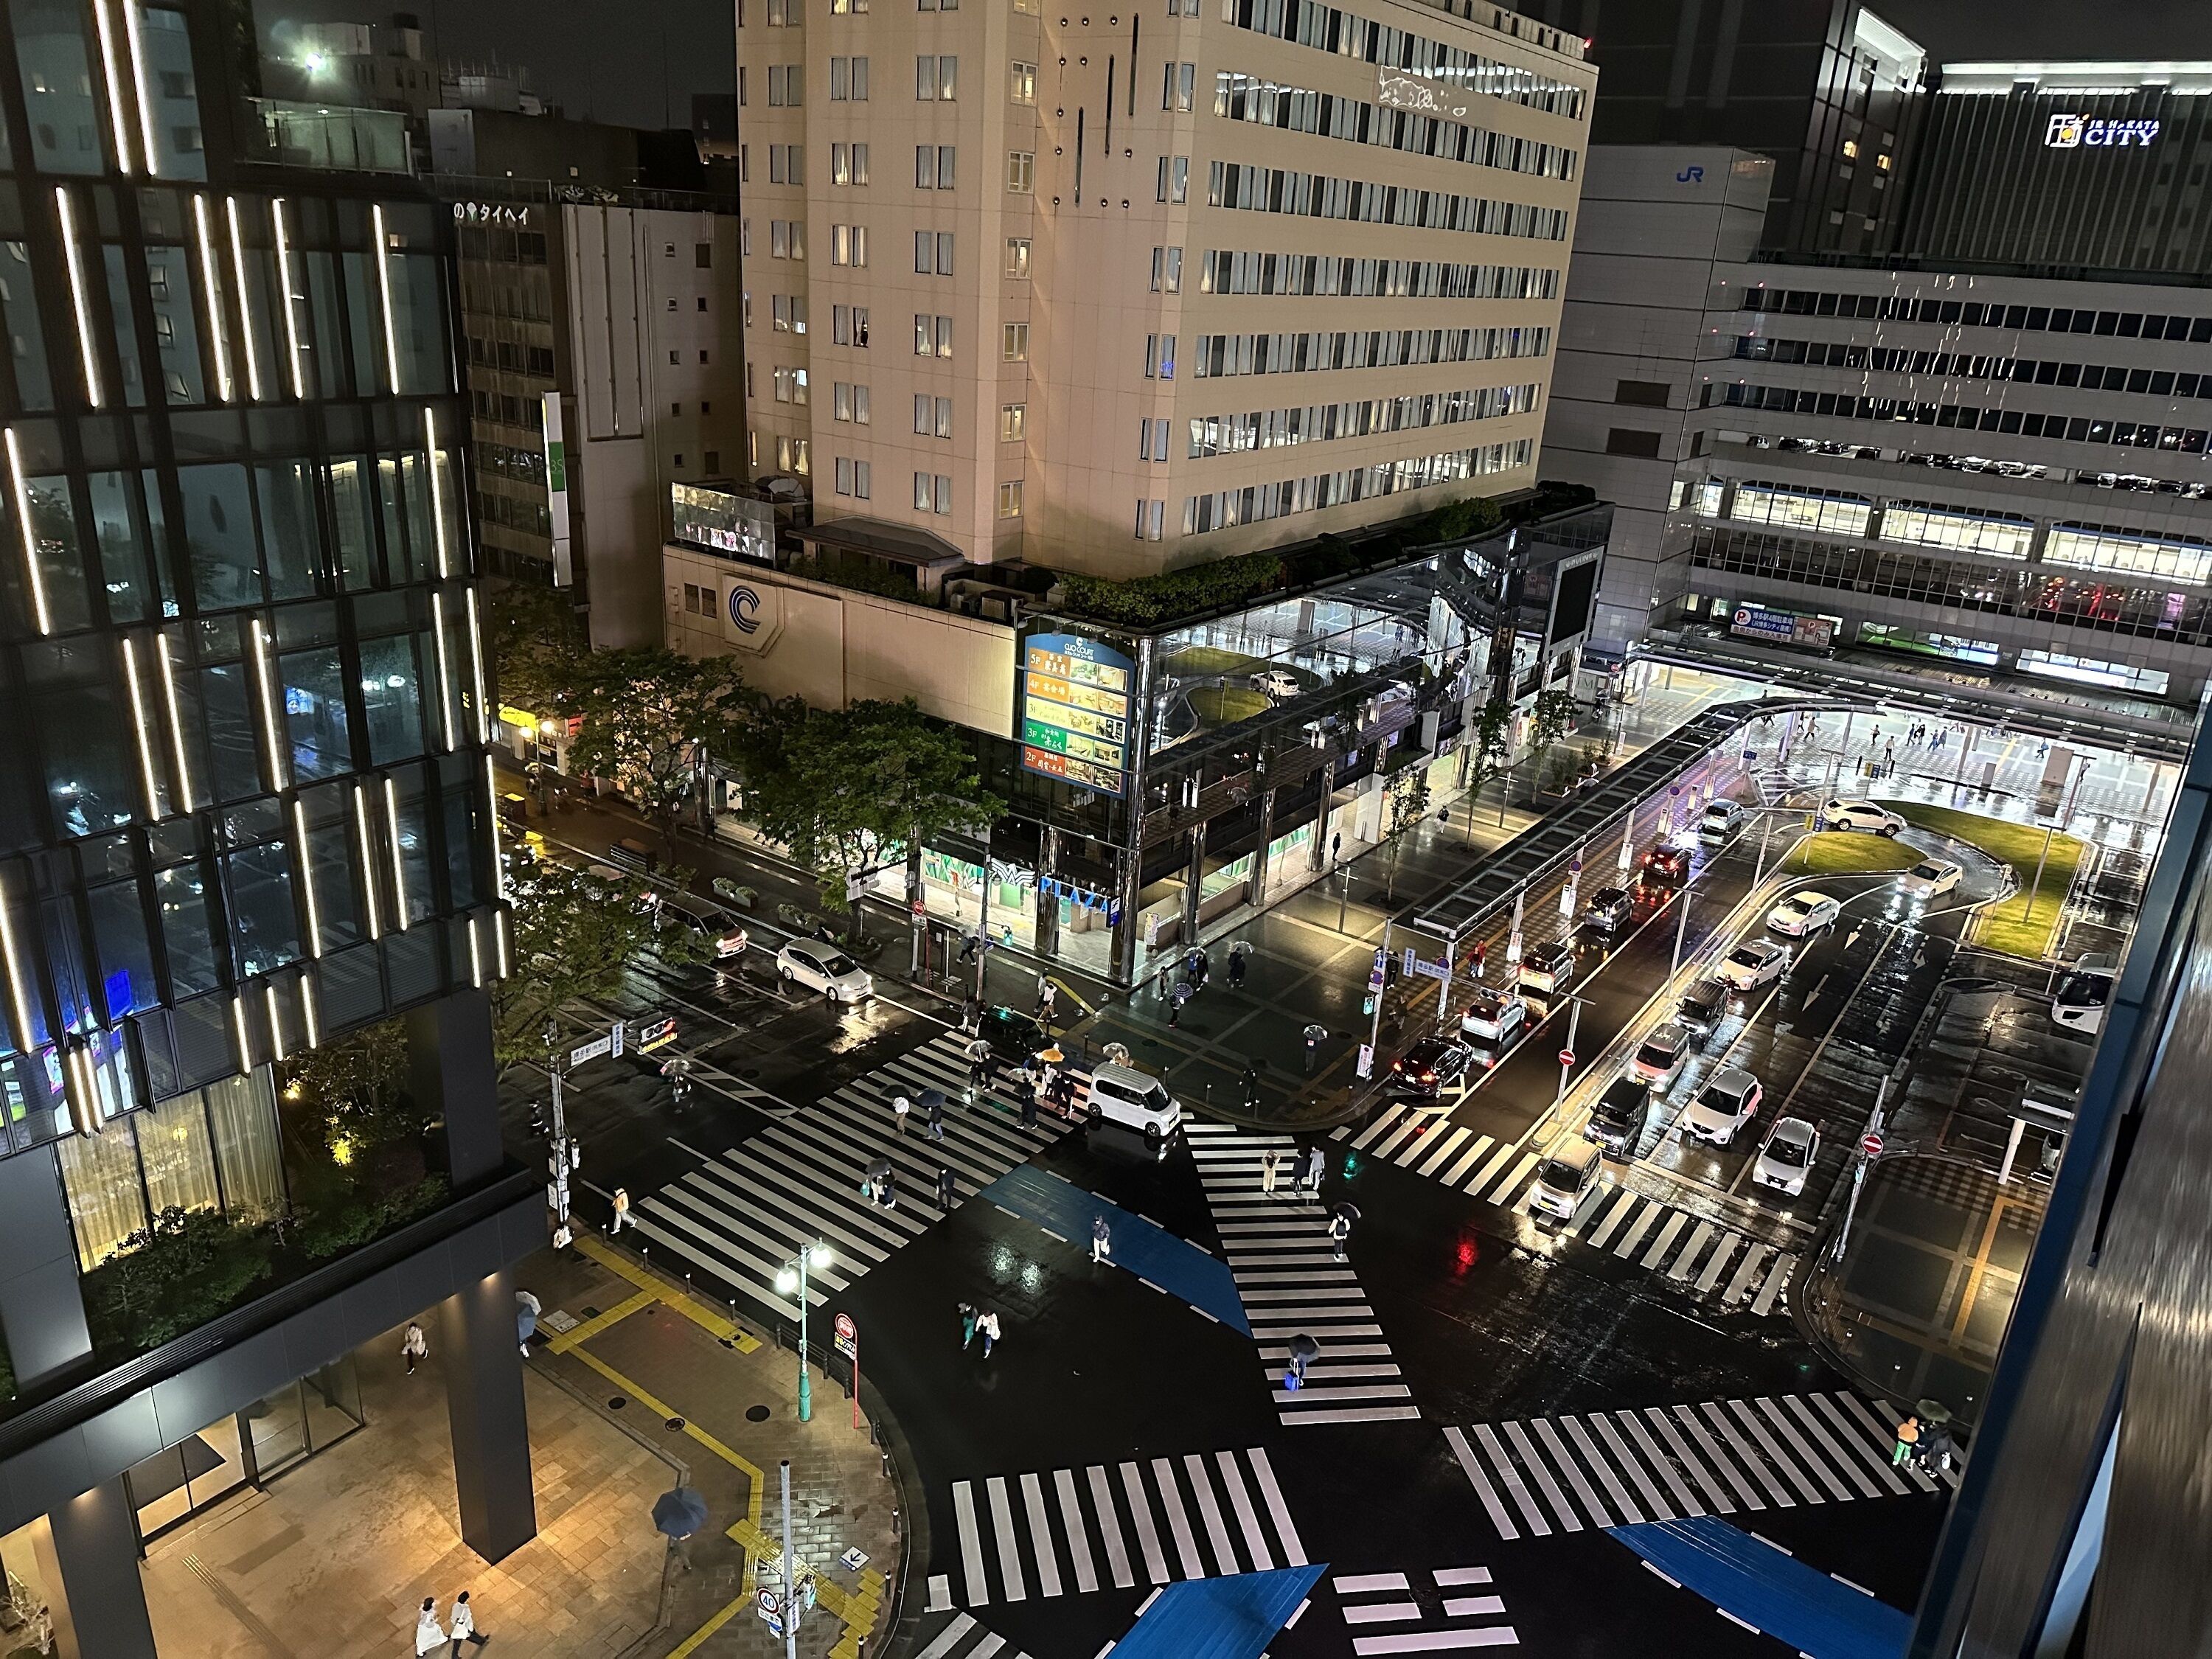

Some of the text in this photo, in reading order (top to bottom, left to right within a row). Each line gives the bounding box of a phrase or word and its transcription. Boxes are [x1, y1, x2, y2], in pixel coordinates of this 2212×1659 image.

[2085, 129, 2159, 146] CITY
[1676, 166, 1704, 183] JR
[480, 204, 529, 226] タイヘイ
[1030, 653, 1041, 664] 5F
[1029, 681, 1040, 689] 4F
[1027, 727, 1037, 738] 3F
[1026, 751, 1037, 762] 2F
[1040, 876, 1107, 913] PLAZA
[762, 1596, 775, 1609] 40
